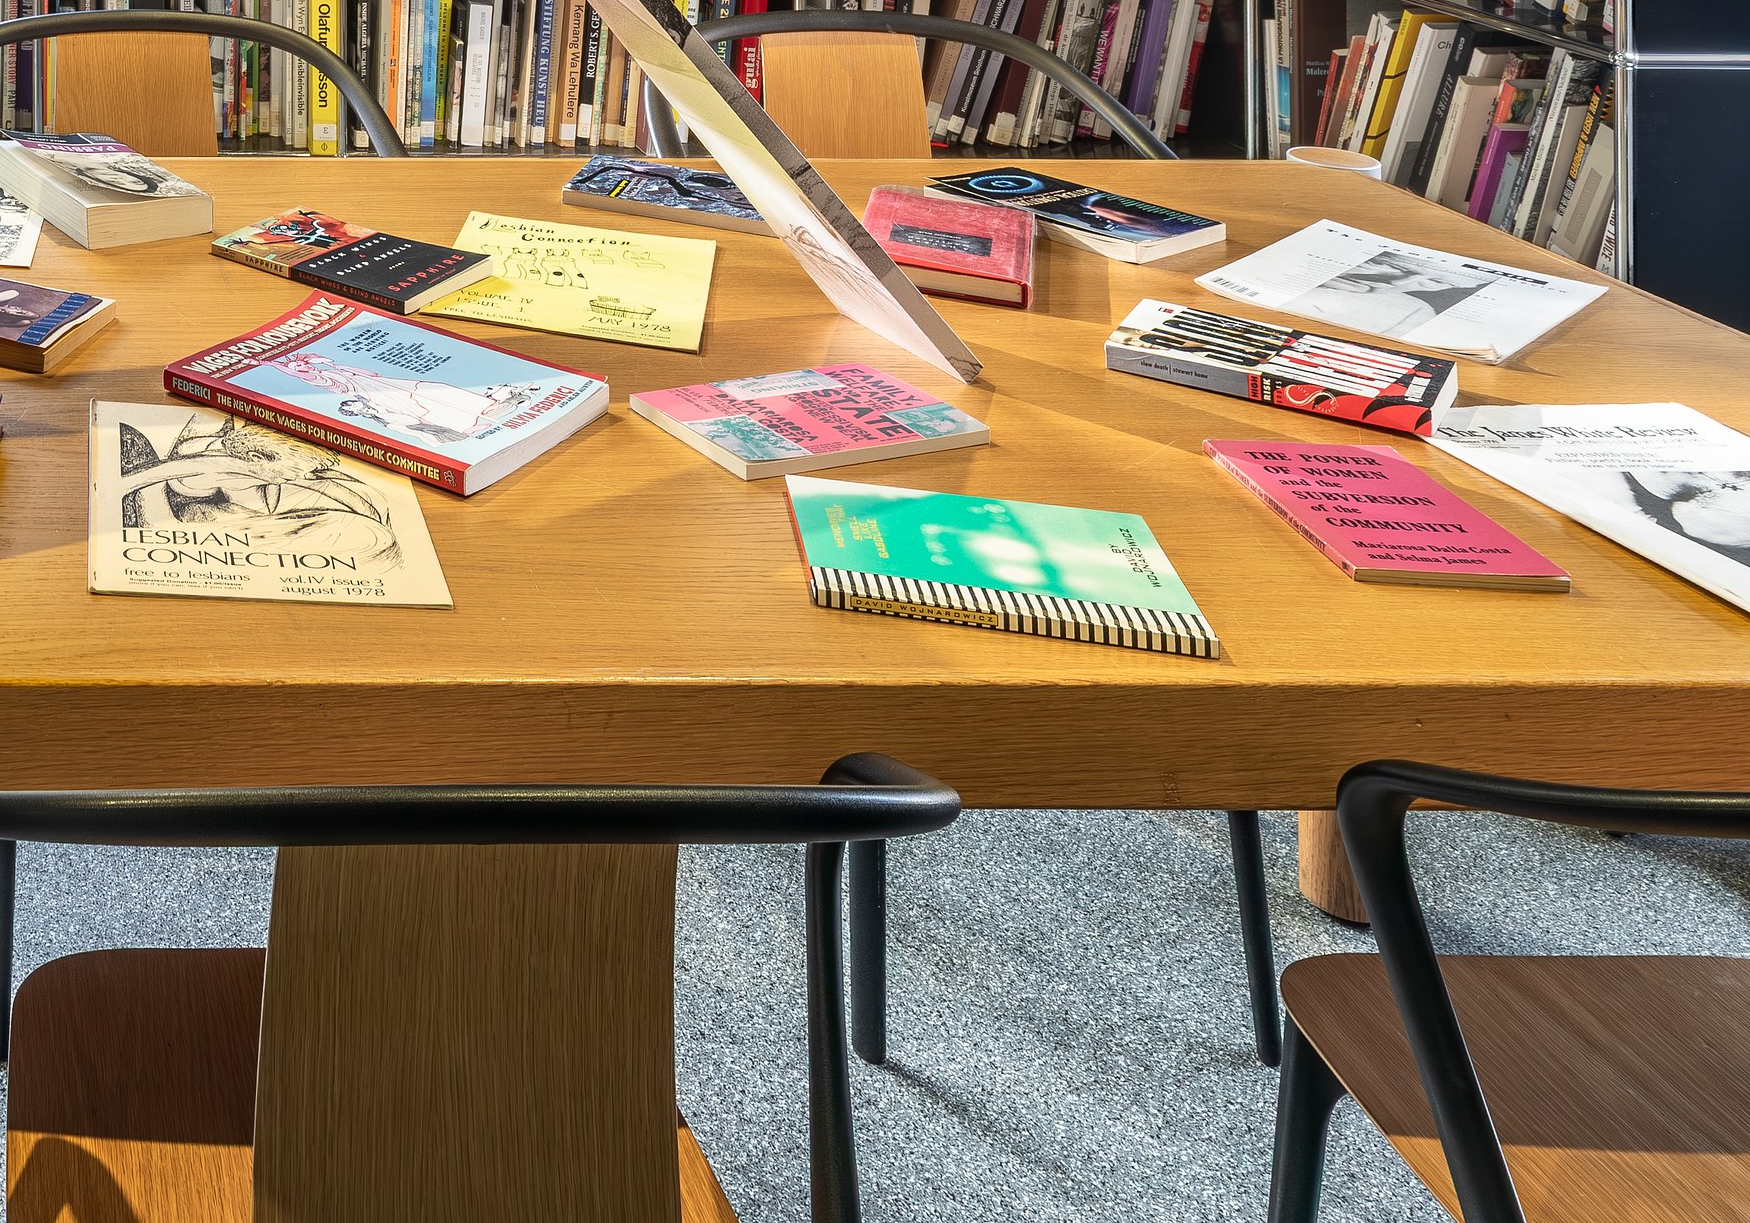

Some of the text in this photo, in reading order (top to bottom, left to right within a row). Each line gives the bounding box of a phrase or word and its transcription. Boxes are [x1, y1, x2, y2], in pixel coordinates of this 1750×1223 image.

[566, 5, 584, 118] Kemang Wa Lehulere
[521, 233, 632, 246] Connection
[308, 250, 346, 268] BLACK
[351, 236, 387, 253] WINGS
[336, 242, 412, 276] BLIND ANGELS
[245, 255, 284, 273] SAPPHIRE
[388, 253, 465, 293] SAPPHIRE
[589, 316, 672, 333] MAY 1978
[182, 297, 345, 374] WAGES FOR HOUSEWORK
[841, 368, 923, 407] FAMILY,
[1251, 375, 1271, 401] HIGH RISK
[502, 385, 577, 431] SILVIA FEDERICI
[812, 390, 915, 438] STATE
[172, 377, 440, 481] FEDERICI THE NEW YORK WAGES FOR HOUSEWORK COMMITTEE
[1244, 451, 1383, 467] THE POWER
[1263, 465, 1389, 481] OF WOMEN
[1278, 478, 1343, 489] and the
[1291, 490, 1437, 507] SUBVERSION
[1310, 504, 1362, 514] of the
[1325, 517, 1468, 533] COMMUNITY
[121, 529, 251, 547] LESBIAN
[1352, 540, 1512, 554] Mariarosa Dalla Costa
[122, 548, 357, 571] CONNECTION
[1369, 552, 1487, 566] and Selma James
[125, 568, 251, 582] free to lesbians
[279, 575, 384, 587] vol.IV issue 3
[281, 585, 385, 597] august 1978
[855, 599, 995, 623] DAVID WOJNAROWICZ
